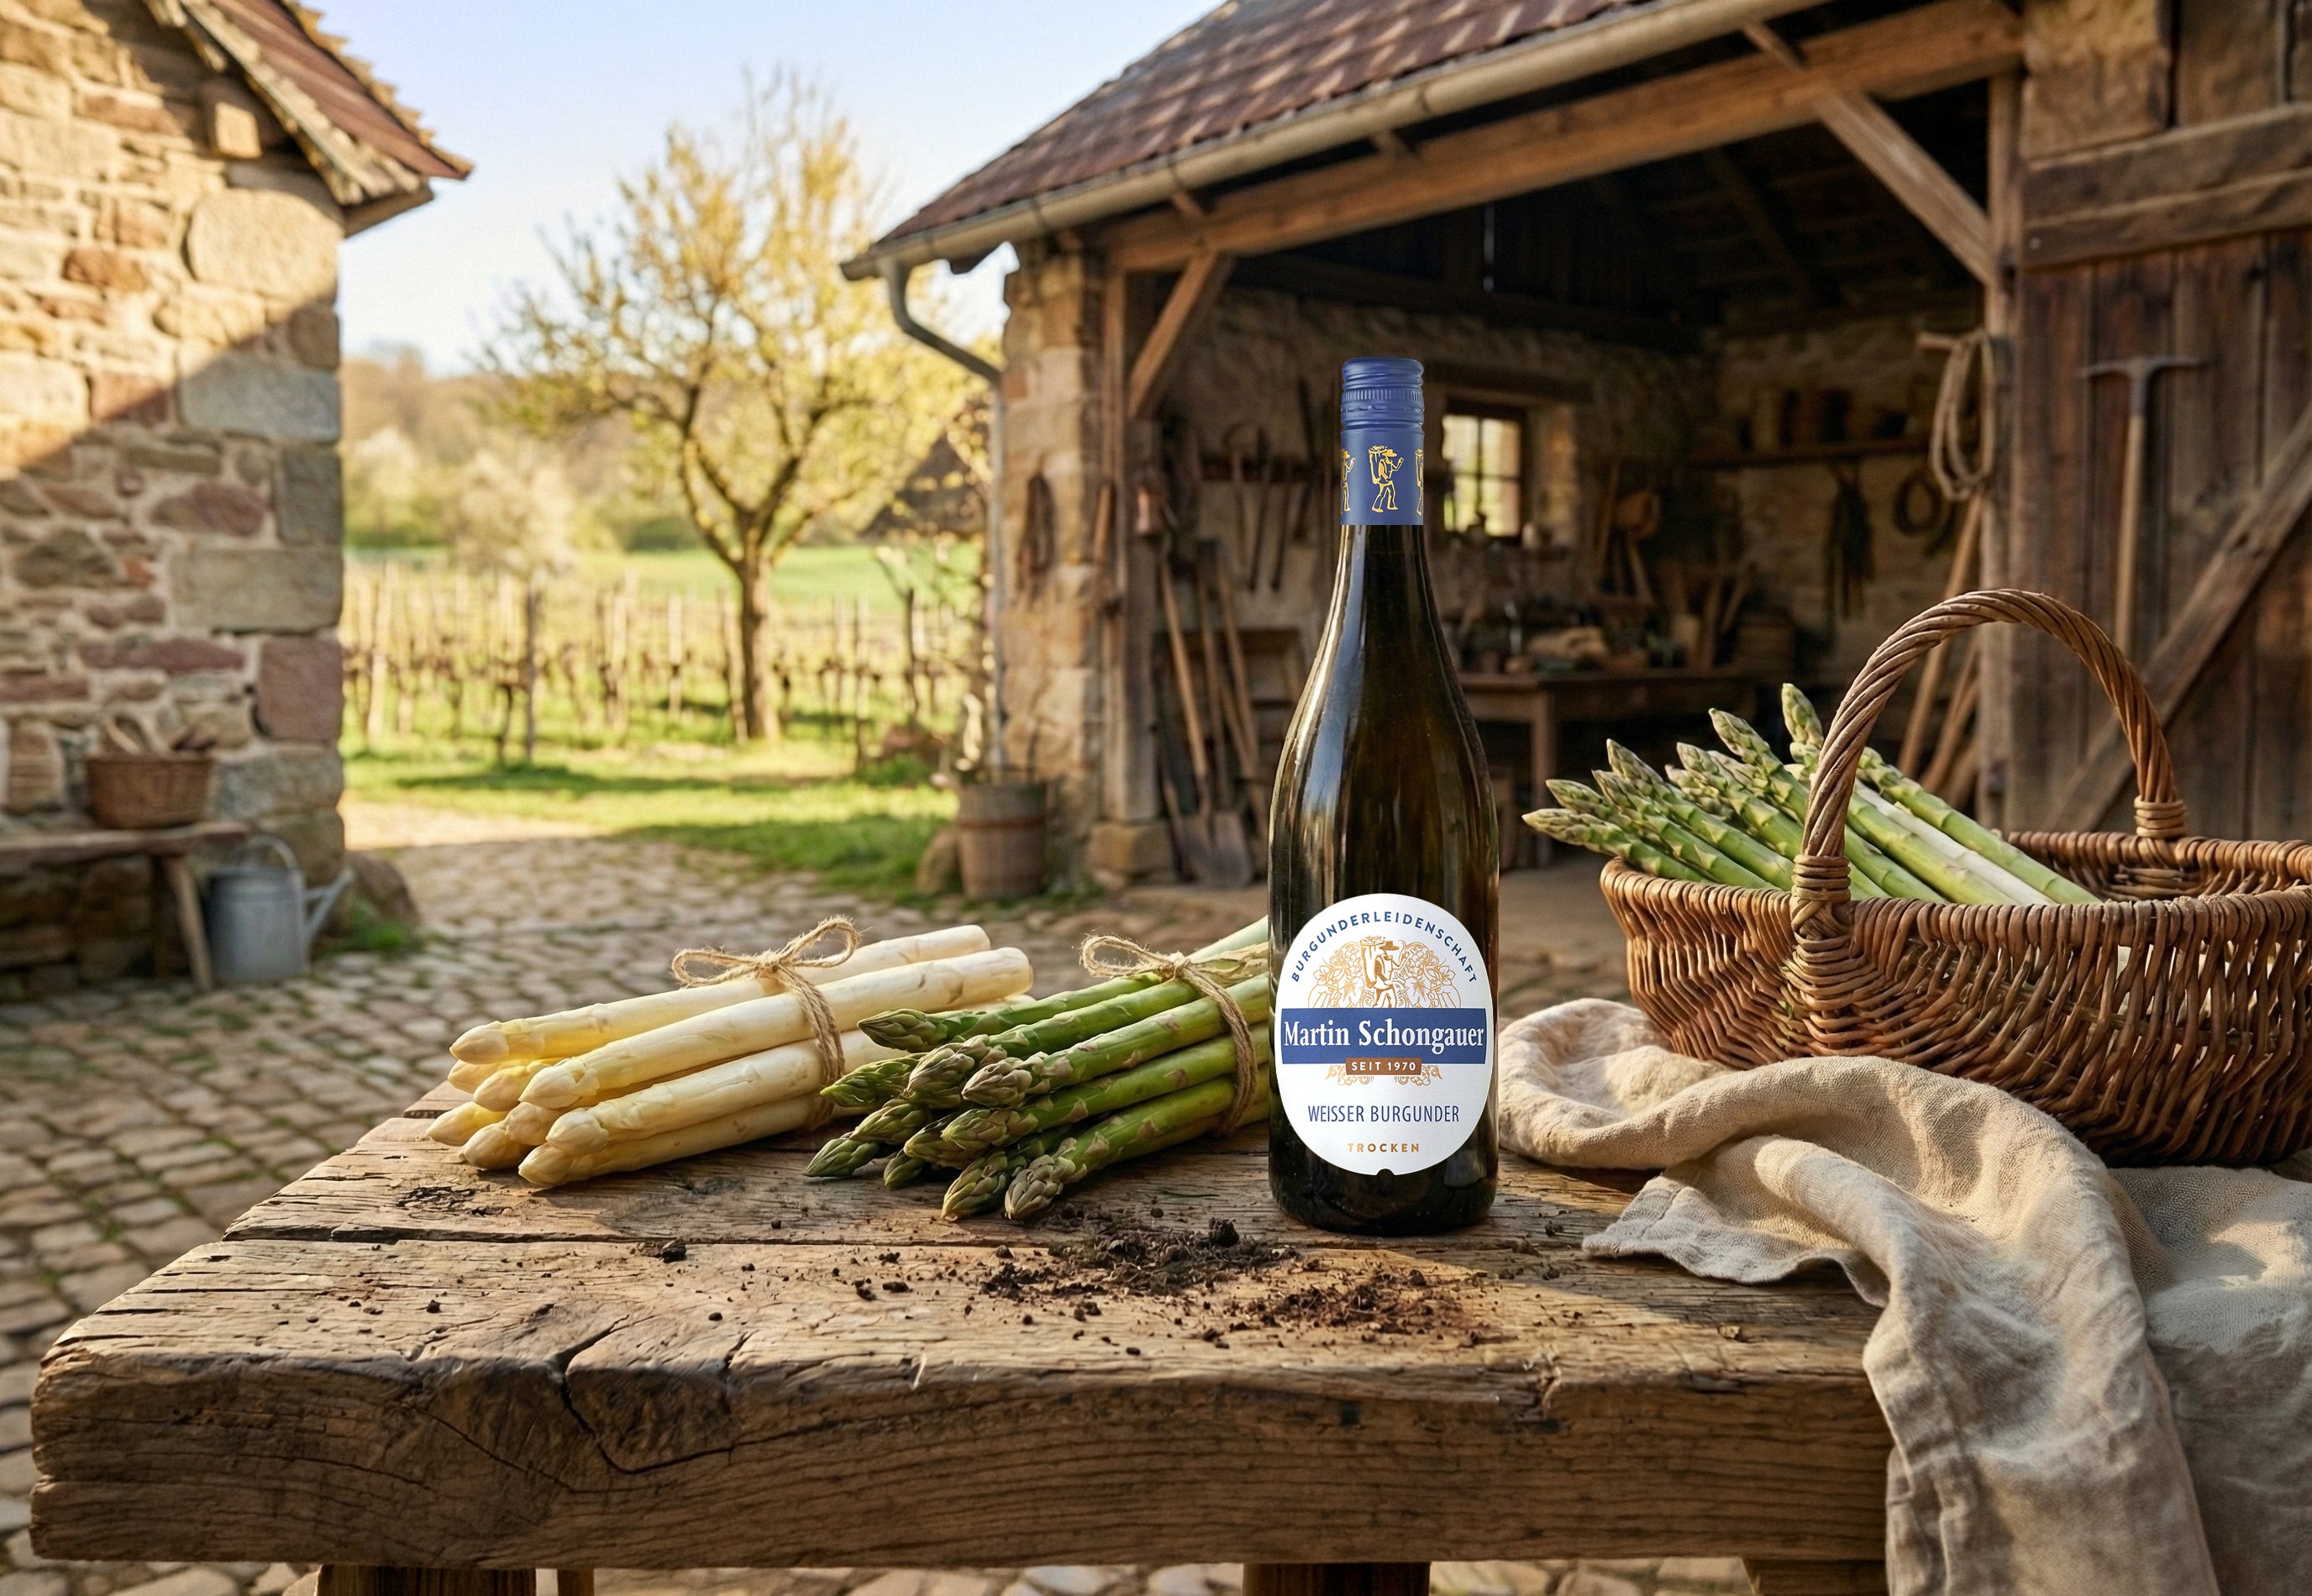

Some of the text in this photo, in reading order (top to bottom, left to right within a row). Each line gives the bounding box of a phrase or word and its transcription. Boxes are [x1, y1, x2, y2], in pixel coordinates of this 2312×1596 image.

[1291, 911, 1477, 984] BURGUNDERLEIDENSCHAFT
[1284, 1018, 1484, 1055] Martin Schongauer
[1351, 1062, 1416, 1071] SEIT 1970
[1307, 1105, 1460, 1122] WEISSER BURGUNDER
[1348, 1143, 1420, 1153] TROCKEN
